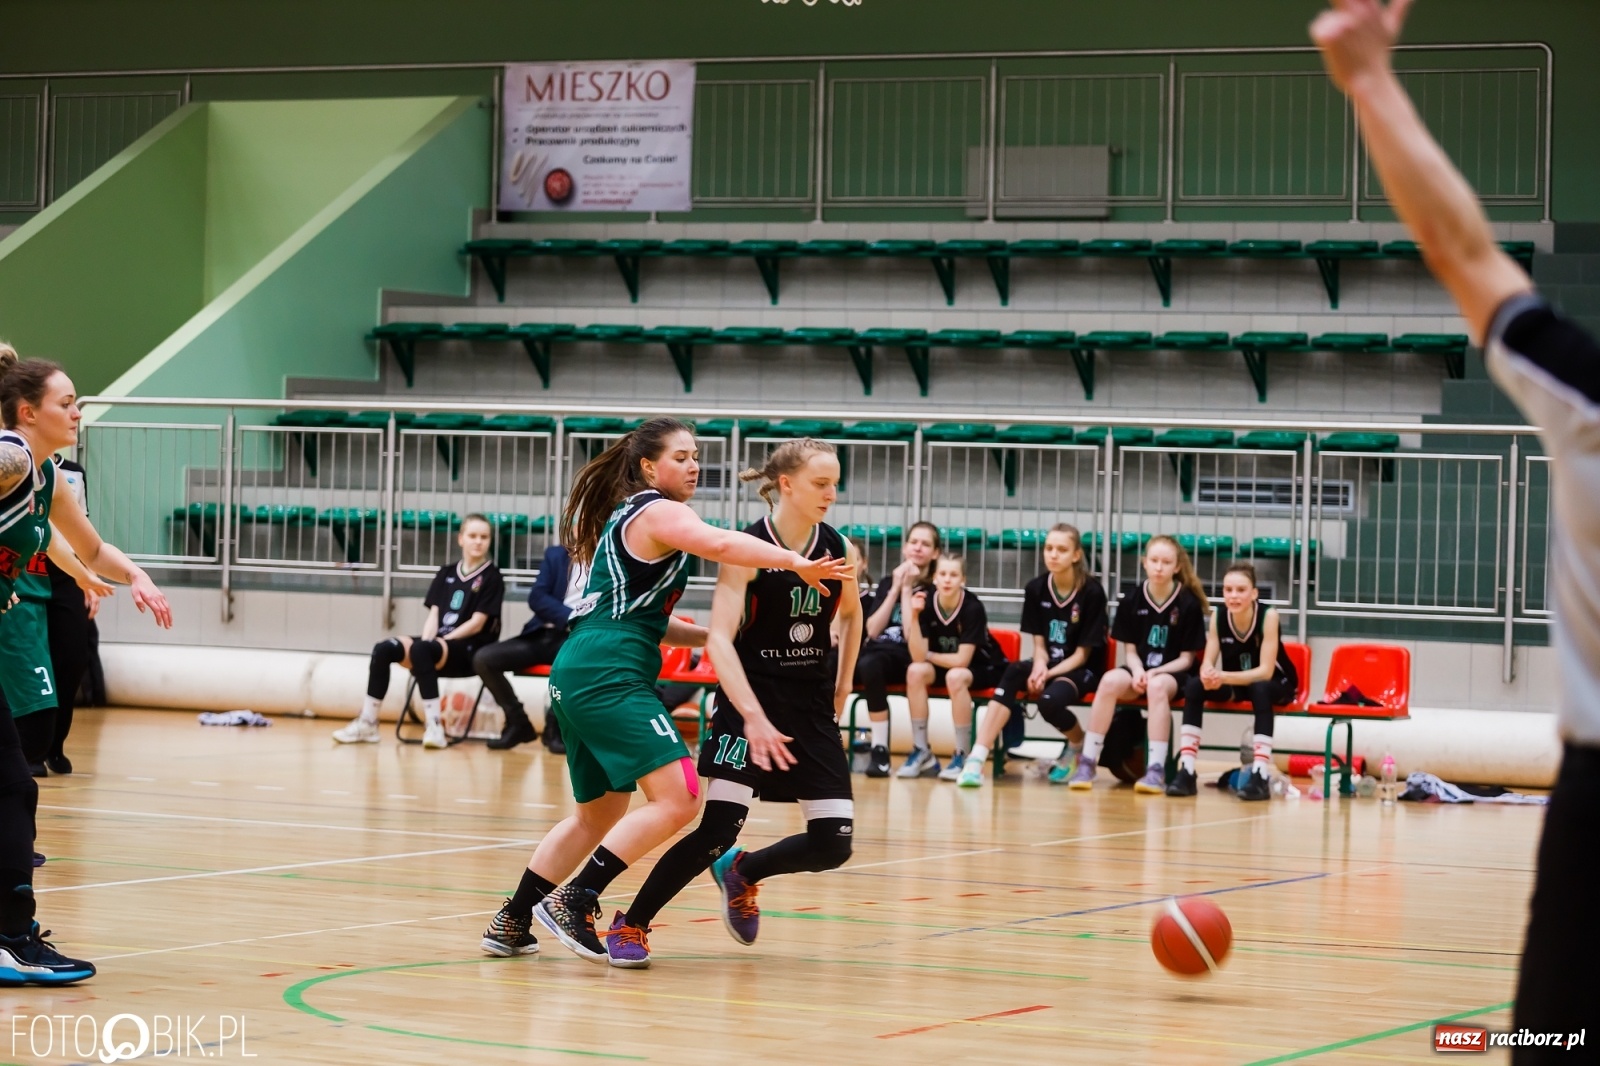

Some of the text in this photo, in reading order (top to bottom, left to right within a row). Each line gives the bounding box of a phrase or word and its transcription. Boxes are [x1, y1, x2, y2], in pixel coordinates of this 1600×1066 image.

[525, 70, 671, 102] MIESZKO
[525, 124, 571, 134] Operator
[525, 136, 640, 147] Pracownik produkcyjny
[790, 586, 822, 617] 14
[760, 649, 782, 658] CTL
[34, 666, 54, 696] 3
[650, 713, 678, 743] 4
[713, 733, 749, 770] 14
